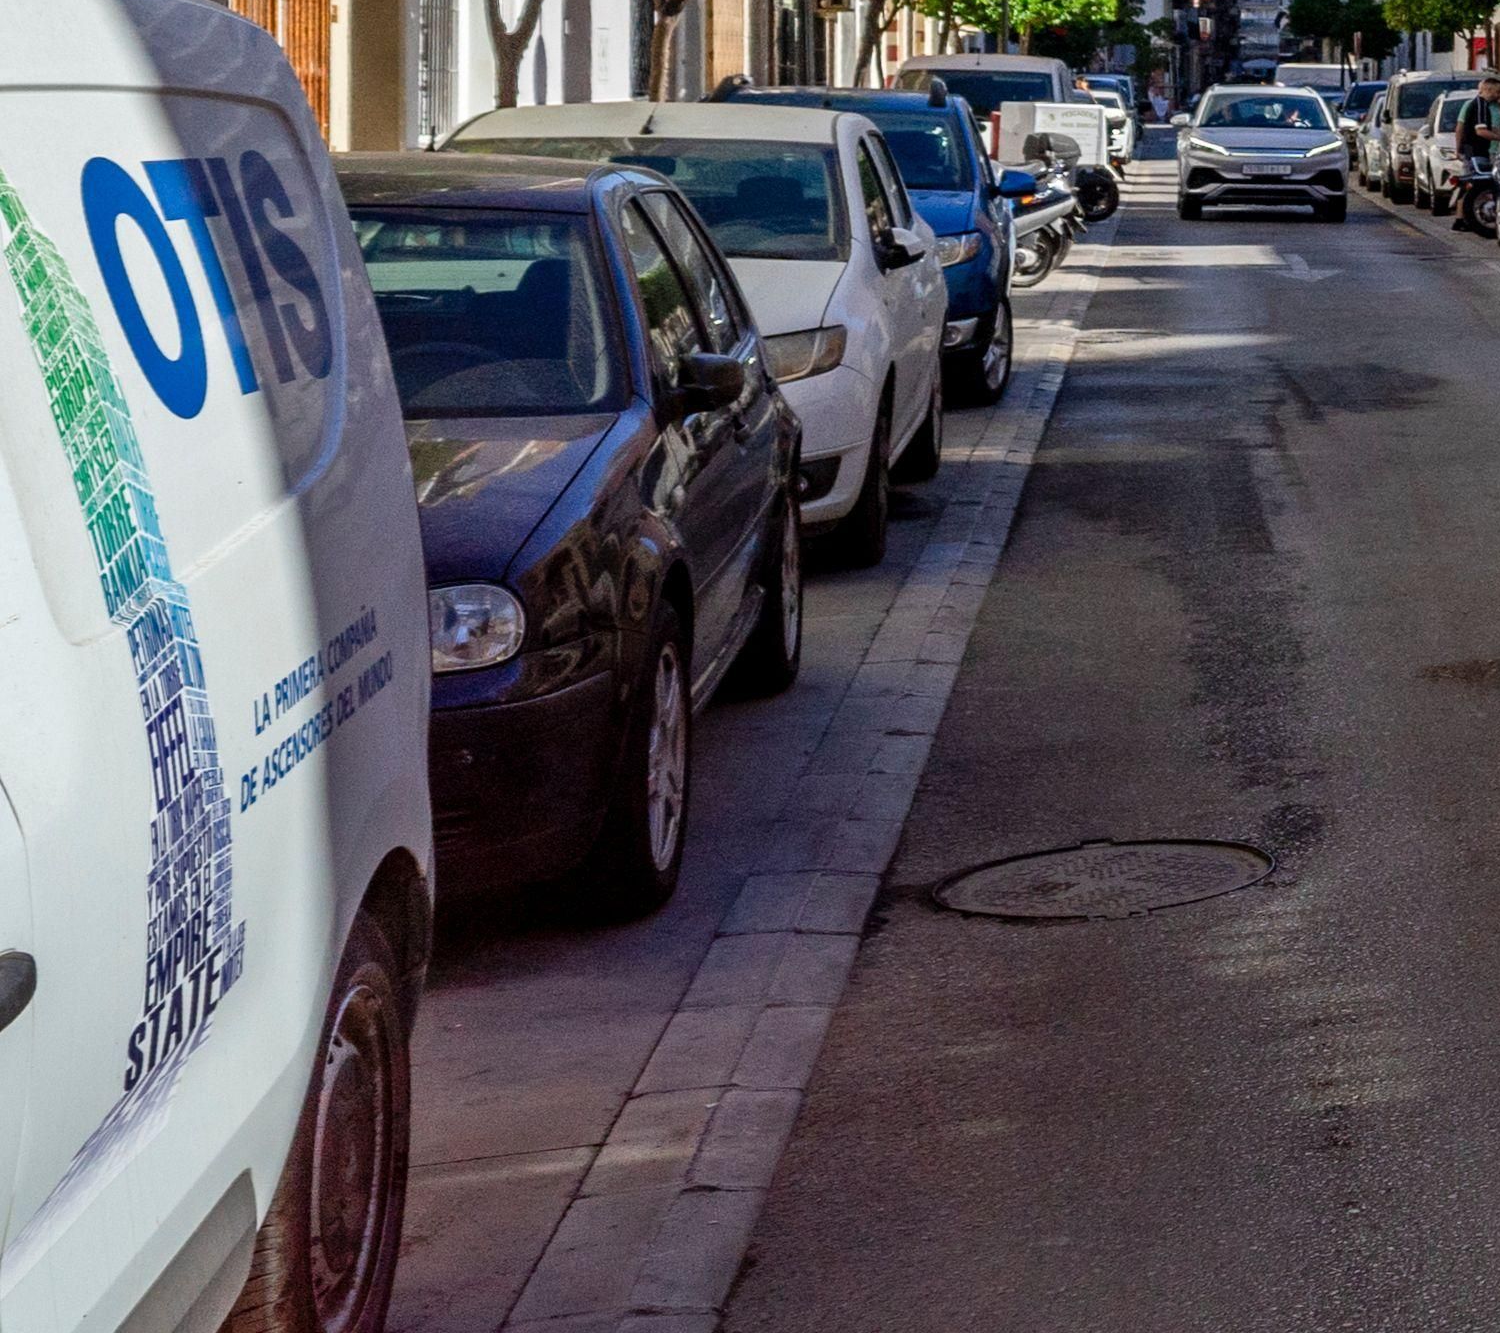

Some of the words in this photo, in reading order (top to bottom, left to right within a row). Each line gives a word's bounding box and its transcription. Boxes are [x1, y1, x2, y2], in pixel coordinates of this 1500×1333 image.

[81, 149, 333, 420] OTIS
[51, 359, 96, 438] EUROPA
[88, 482, 137, 572] TORRE
[100, 536, 150, 618] BANKIA
[241, 766, 258, 813] DE
[261, 701, 333, 795] ASCENSORES
[336, 685, 355, 727] DEL
[358, 650, 393, 707] MUNDO
[254, 693, 271, 736] LA
[274, 650, 324, 719] PRIMERA
[146, 694, 195, 814] EIFFEL
[144, 897, 214, 1016] EMPIRE
[147, 888, 188, 955] ESTAMOS
[190, 873, 201, 916] EN
[203, 863, 213, 902] EL
[124, 945, 222, 1091] STATE
